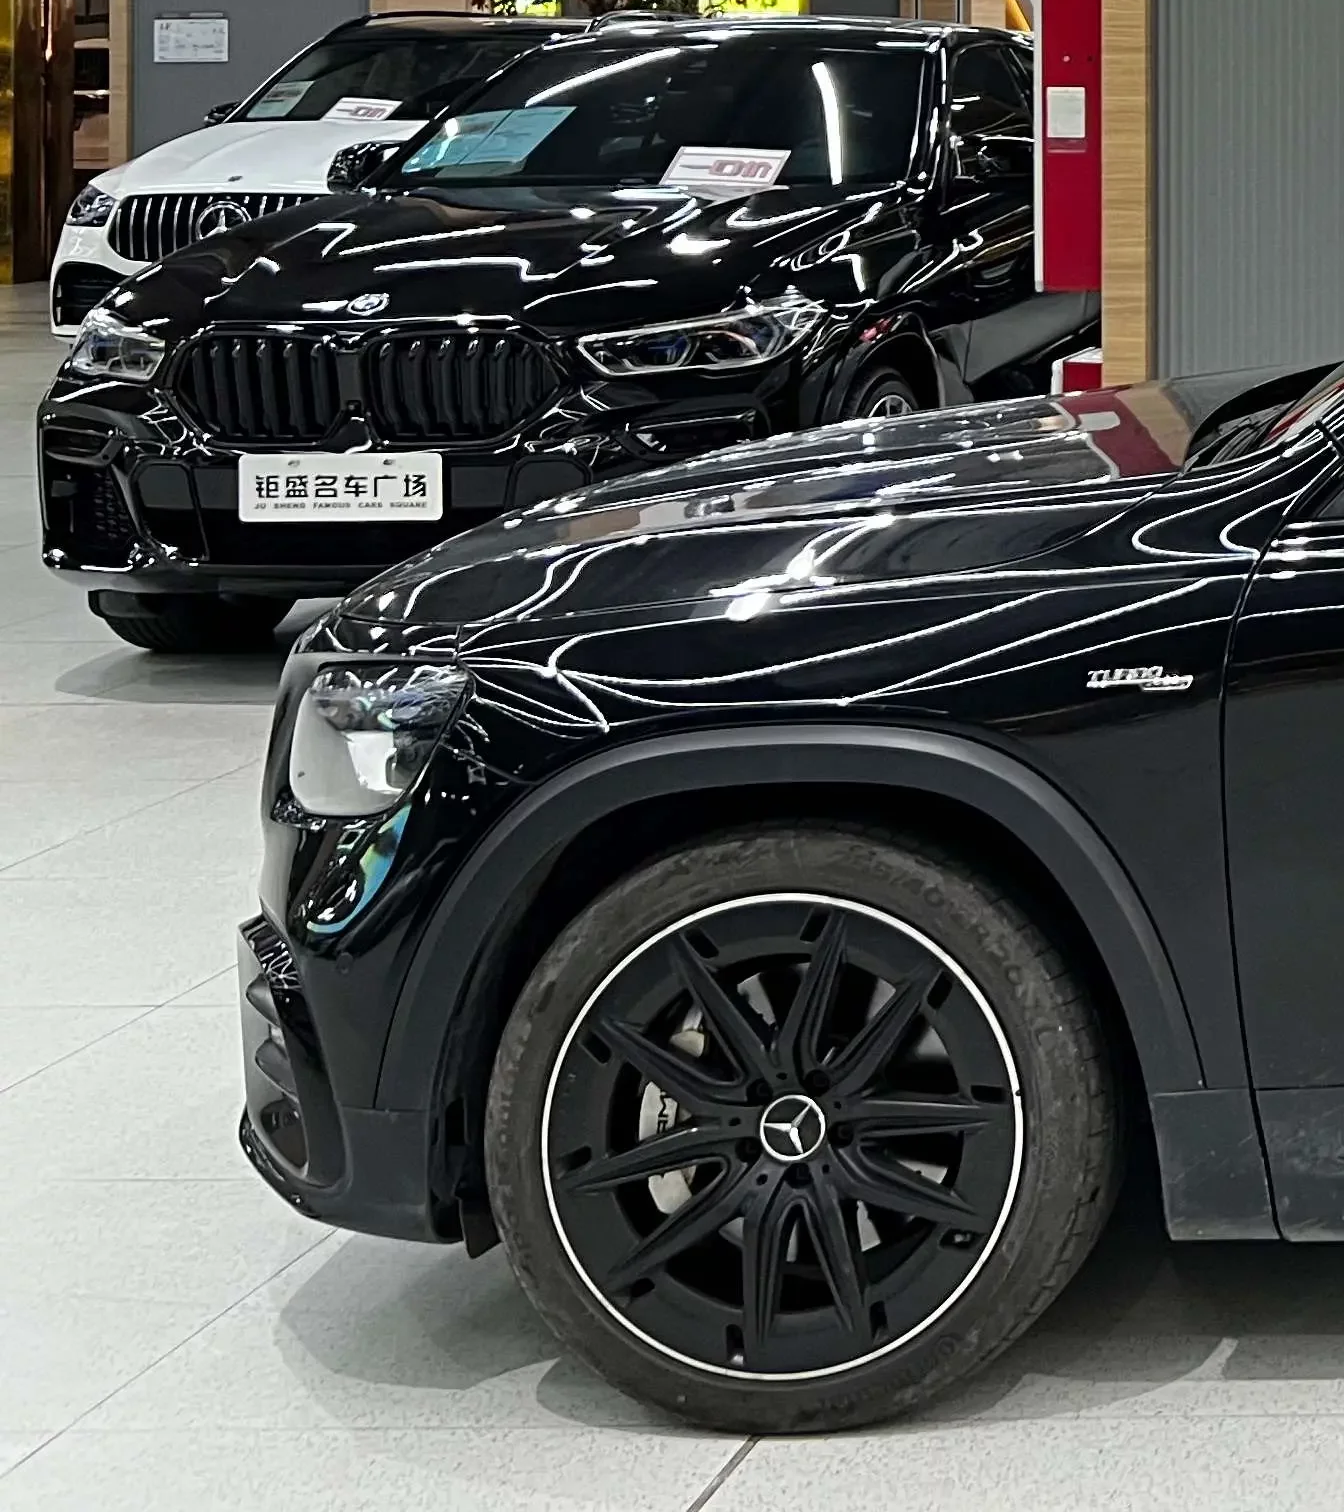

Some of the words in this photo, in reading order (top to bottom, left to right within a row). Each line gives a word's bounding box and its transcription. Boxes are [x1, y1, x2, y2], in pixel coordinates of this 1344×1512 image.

[255, 474, 427, 498] 钜盛名车广场
